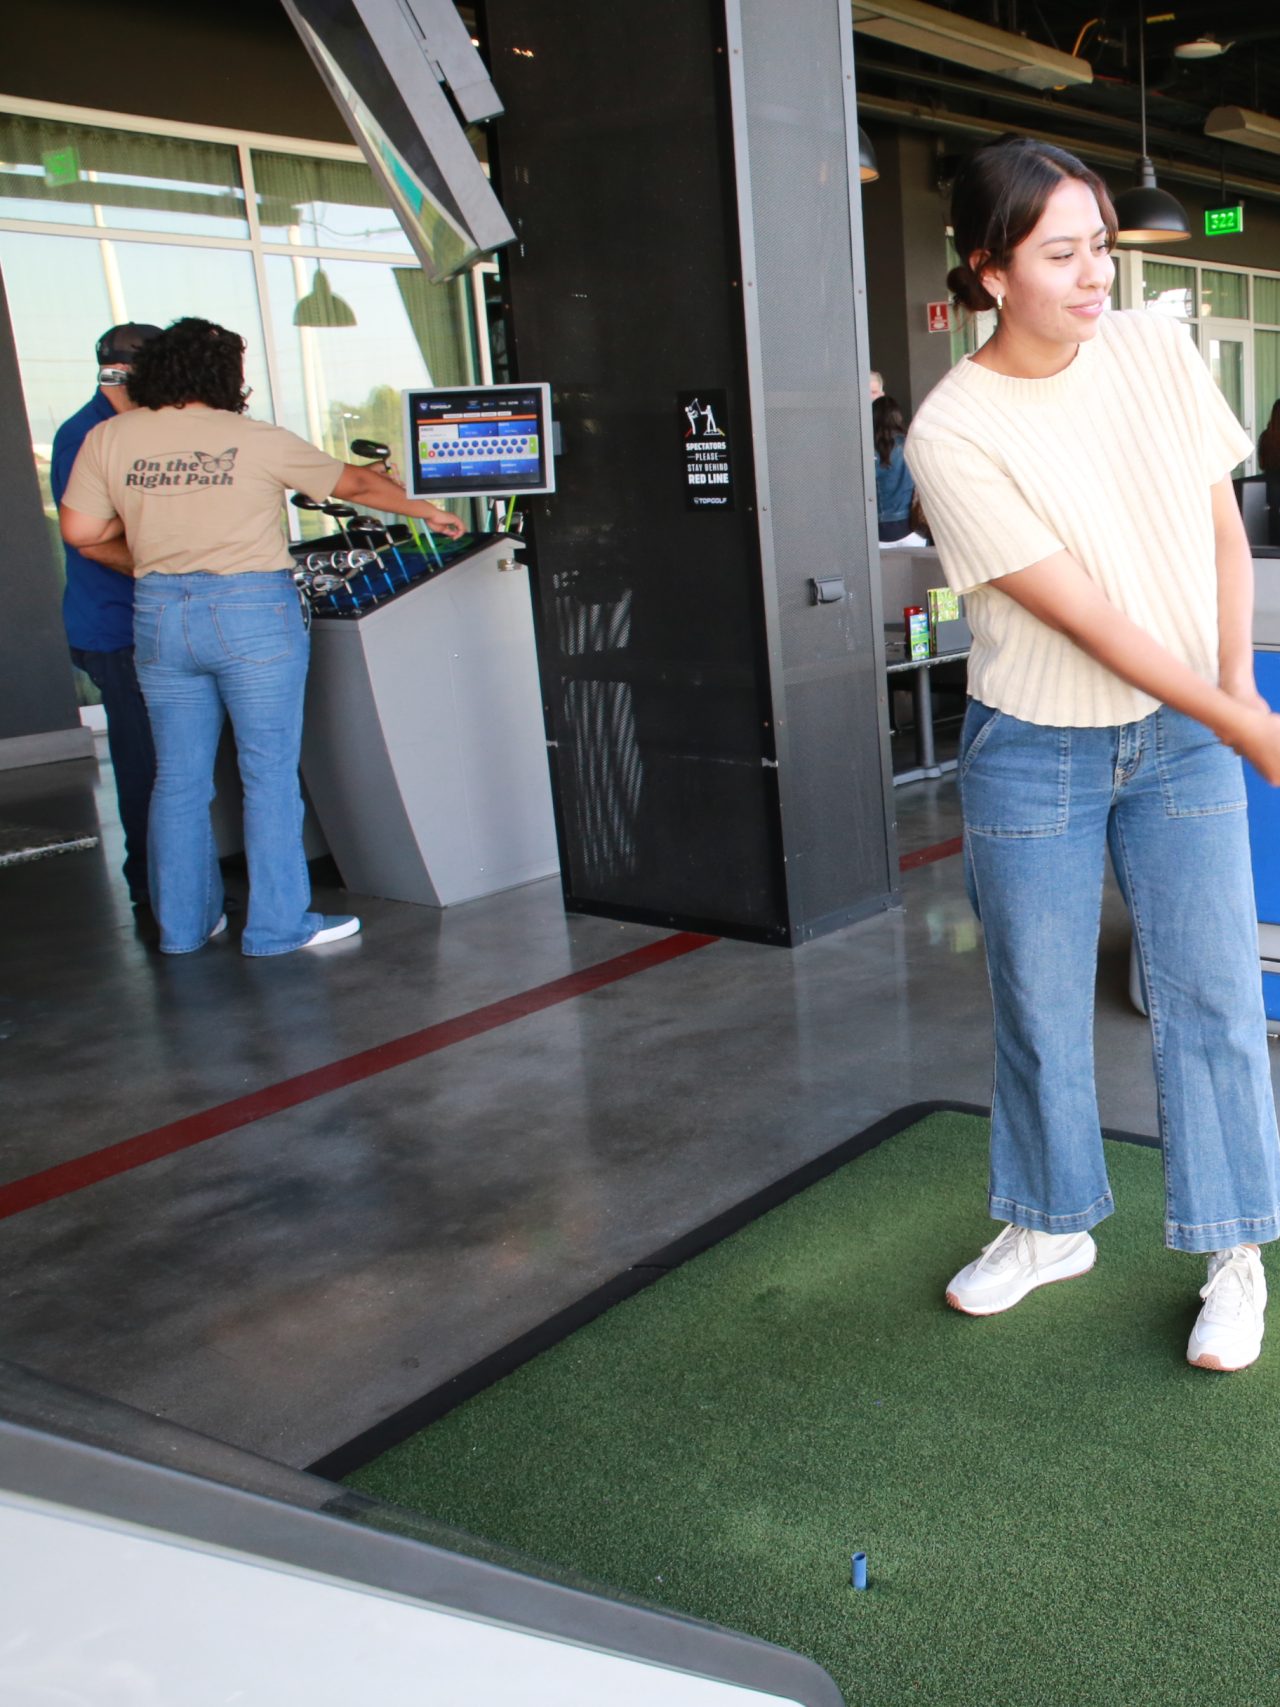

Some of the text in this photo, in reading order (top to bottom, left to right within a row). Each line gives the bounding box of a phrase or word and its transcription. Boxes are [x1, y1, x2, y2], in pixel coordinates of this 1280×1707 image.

[1211, 212, 1234, 229] 322
[685, 442, 727, 451] SPECTATORS
[695, 453, 719, 461] PLEASE
[133, 459, 199, 472] On the
[687, 463, 728, 472] STAY BEHIND
[125, 472, 234, 489] Right Path
[688, 473, 729, 484] RED LINE
[699, 497, 727, 505] TOPGOLF
